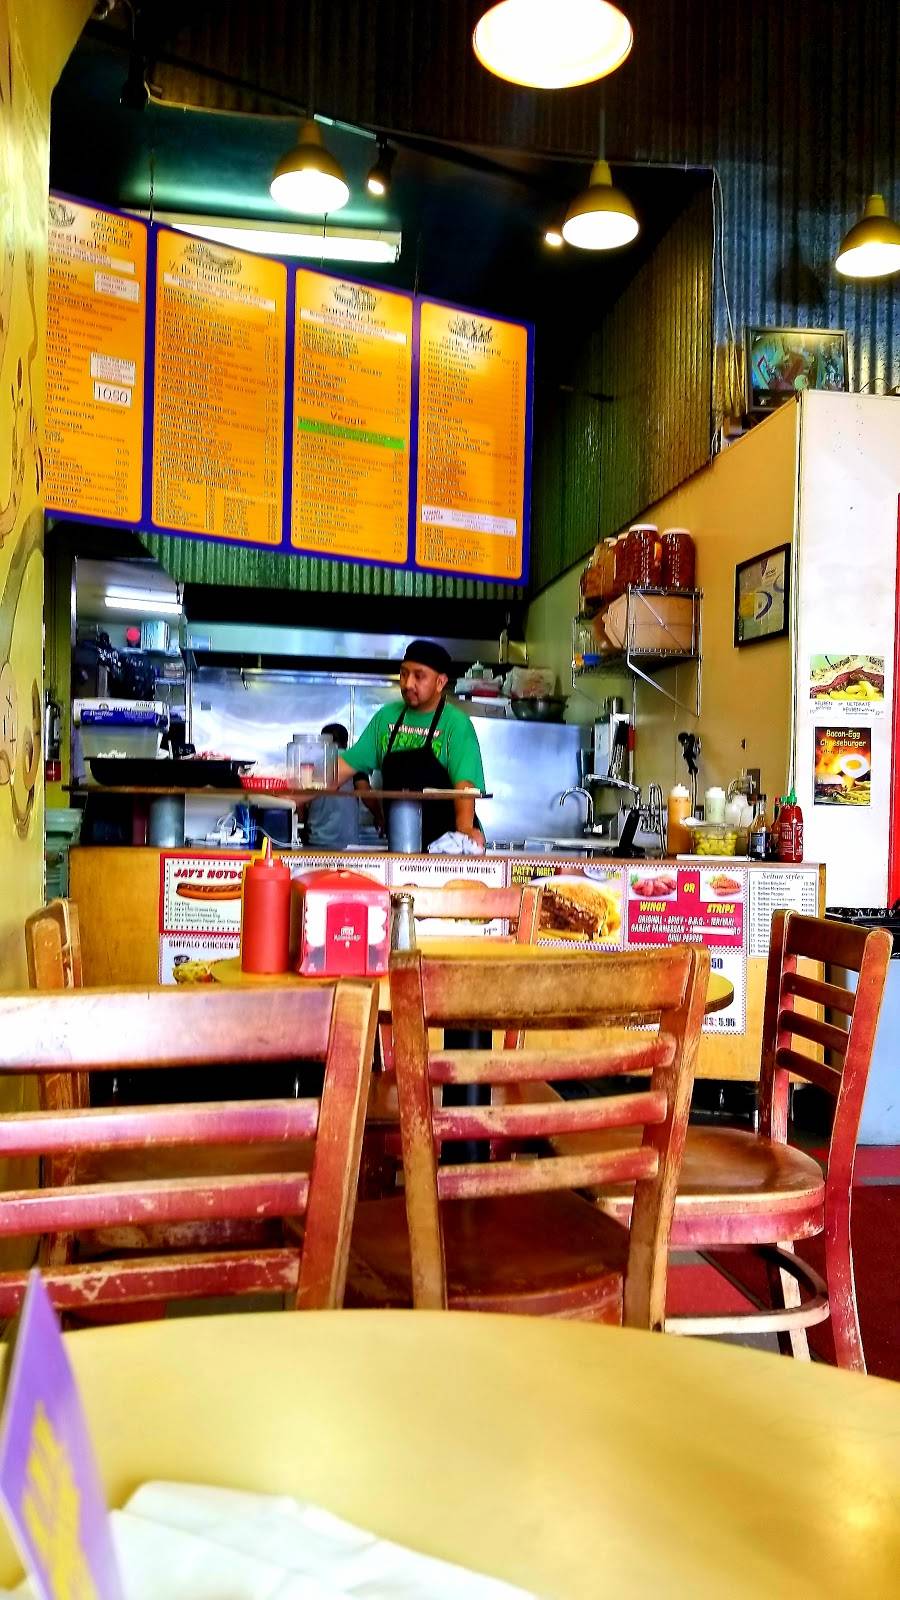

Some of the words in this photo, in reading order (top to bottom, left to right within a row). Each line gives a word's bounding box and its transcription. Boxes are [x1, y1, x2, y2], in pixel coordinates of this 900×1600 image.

[826, 729, 861, 739] Bacon-Egg
[174, 869, 205, 879] JAY'S
[207, 870, 243, 879] HOTDO
[399, 865, 432, 873] COWBOY
[434, 865, 464, 874] BURGER
[466, 866, 497, 875] W/FRIES
[513, 865, 535, 876] PATTY
[537, 866, 555, 877] MELT
[683, 882, 696, 894] OR
[639, 901, 667, 912] WINGS
[706, 902, 736, 914] STRIPS
[631, 923, 651, 933] GARLIC
[683, 934, 703, 943] PEPPER
[168, 940, 200, 949] BUFFALO
[202, 940, 234, 950] CHICKEN
[711, 957, 724, 970] 50
